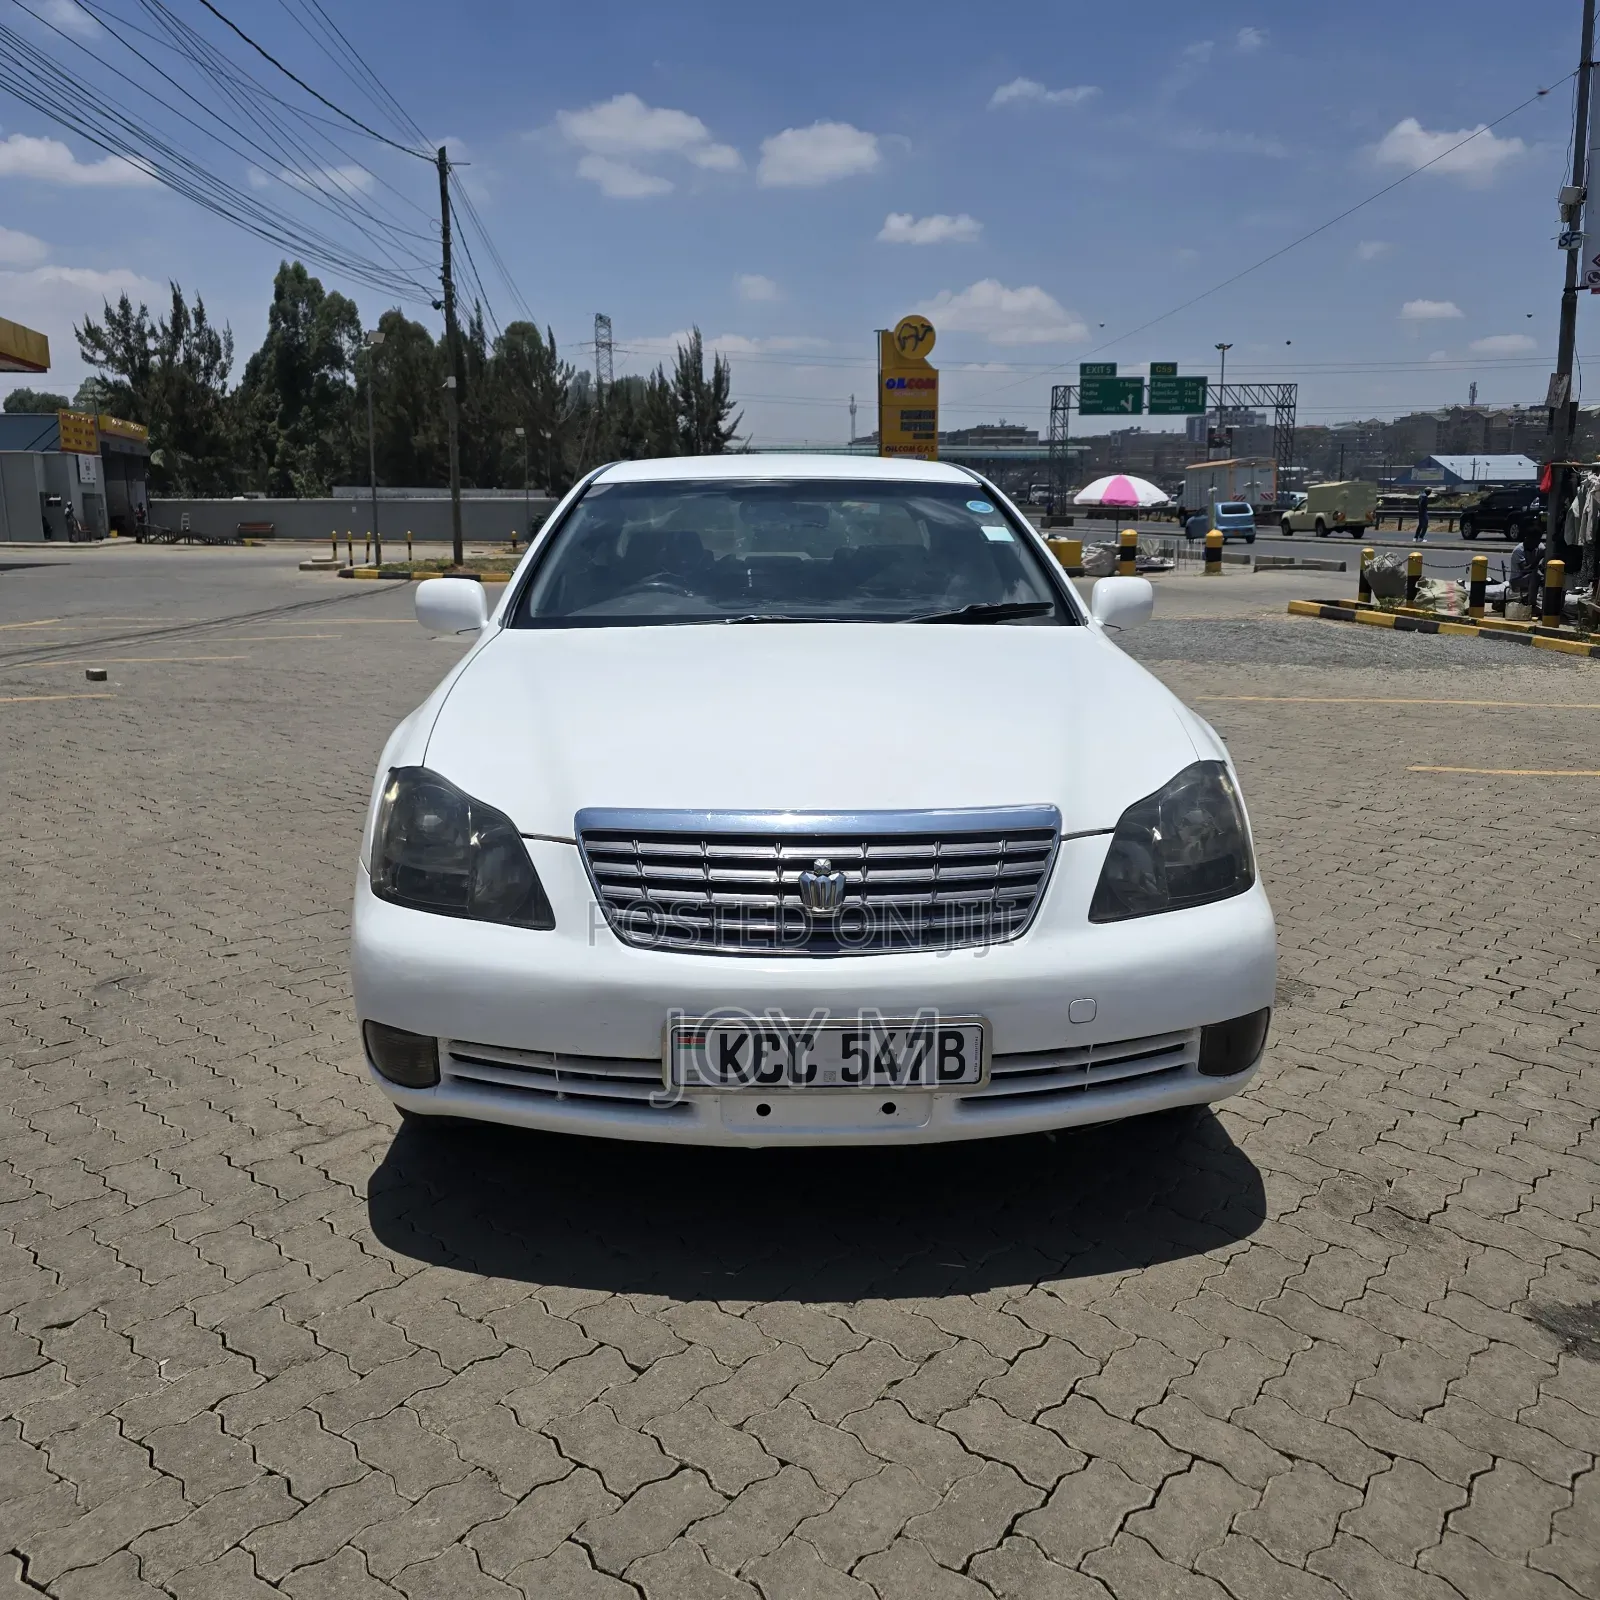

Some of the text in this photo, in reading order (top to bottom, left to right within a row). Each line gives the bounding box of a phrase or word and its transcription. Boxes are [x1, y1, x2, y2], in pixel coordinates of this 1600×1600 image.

[1559, 232, 1580, 247] SF
[1086, 366, 1111, 374] EXIT 5
[885, 445, 935, 453] OILCOM GAS
[719, 1032, 818, 1083] KCC
[841, 1031, 966, 1083] 547B
